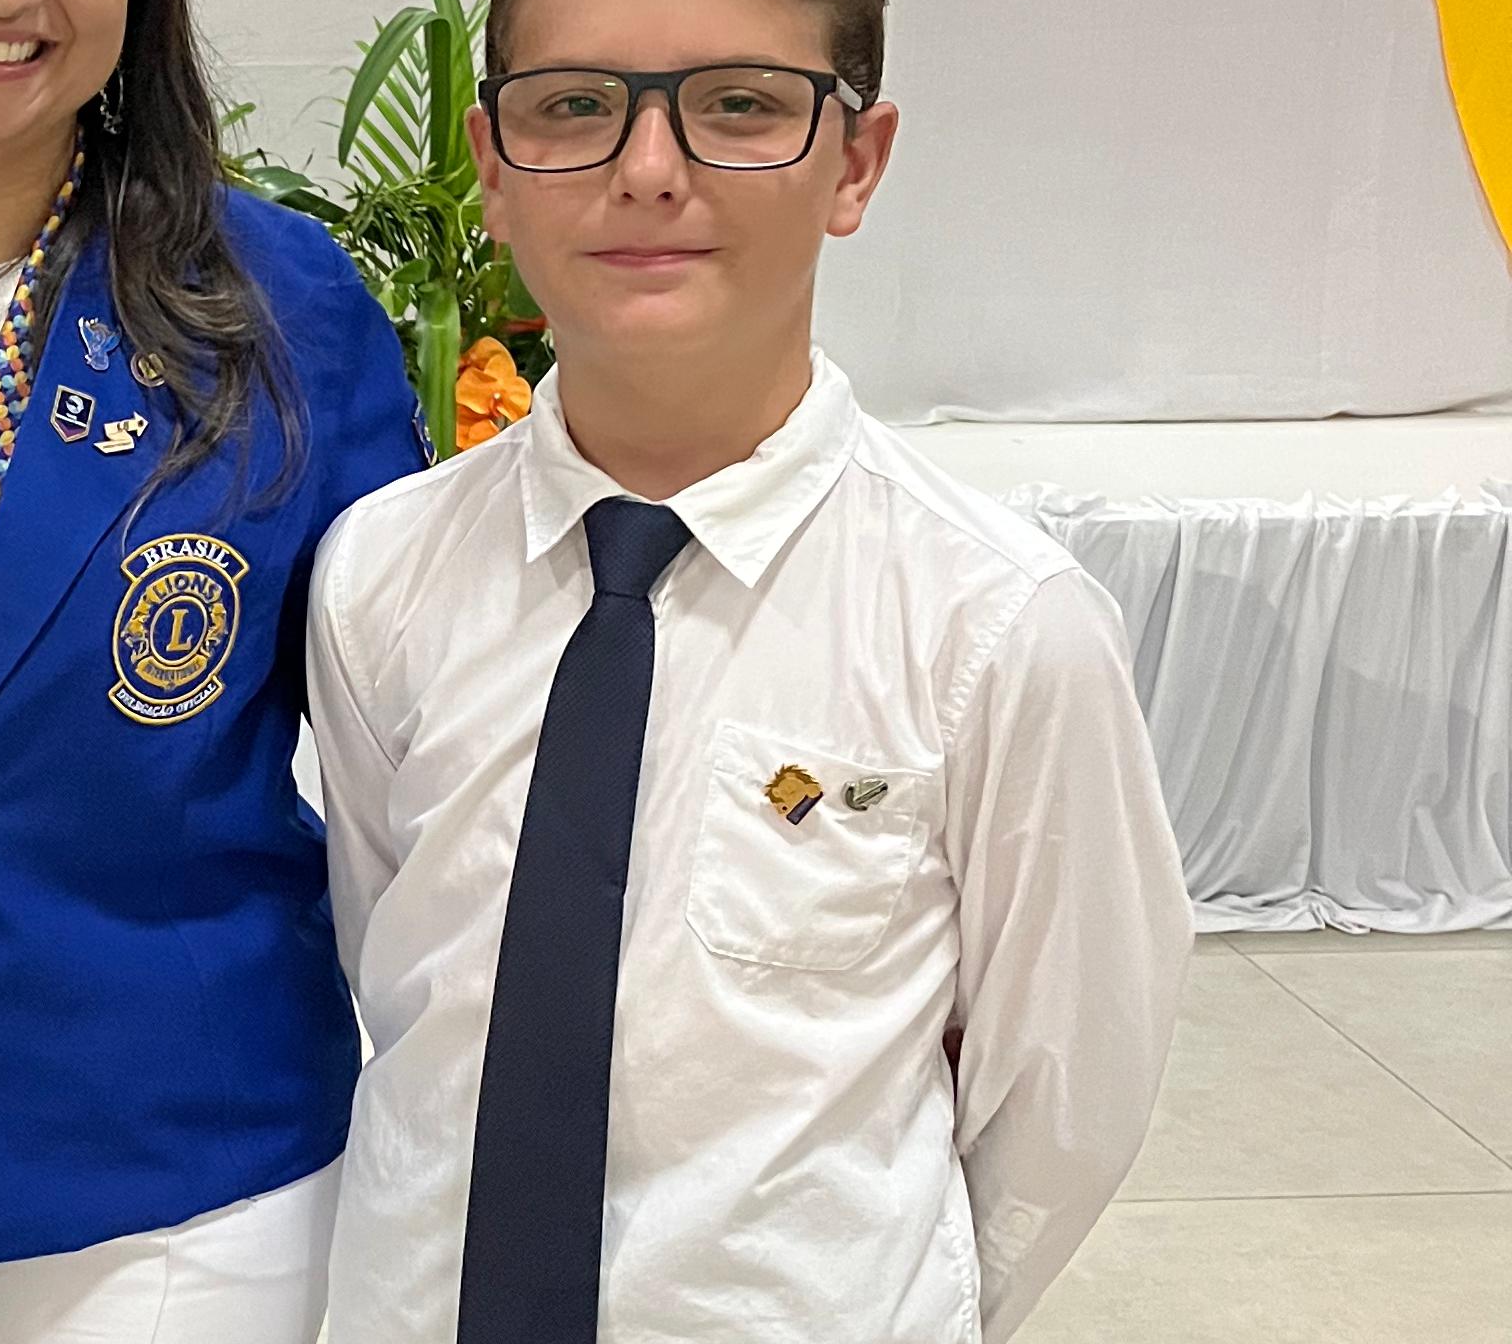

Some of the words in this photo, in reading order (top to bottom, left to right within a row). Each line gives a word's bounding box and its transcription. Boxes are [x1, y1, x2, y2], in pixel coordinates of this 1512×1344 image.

[140, 538, 230, 568] BRASIL
[153, 573, 220, 600] LIONS
[166, 608, 193, 653] L
